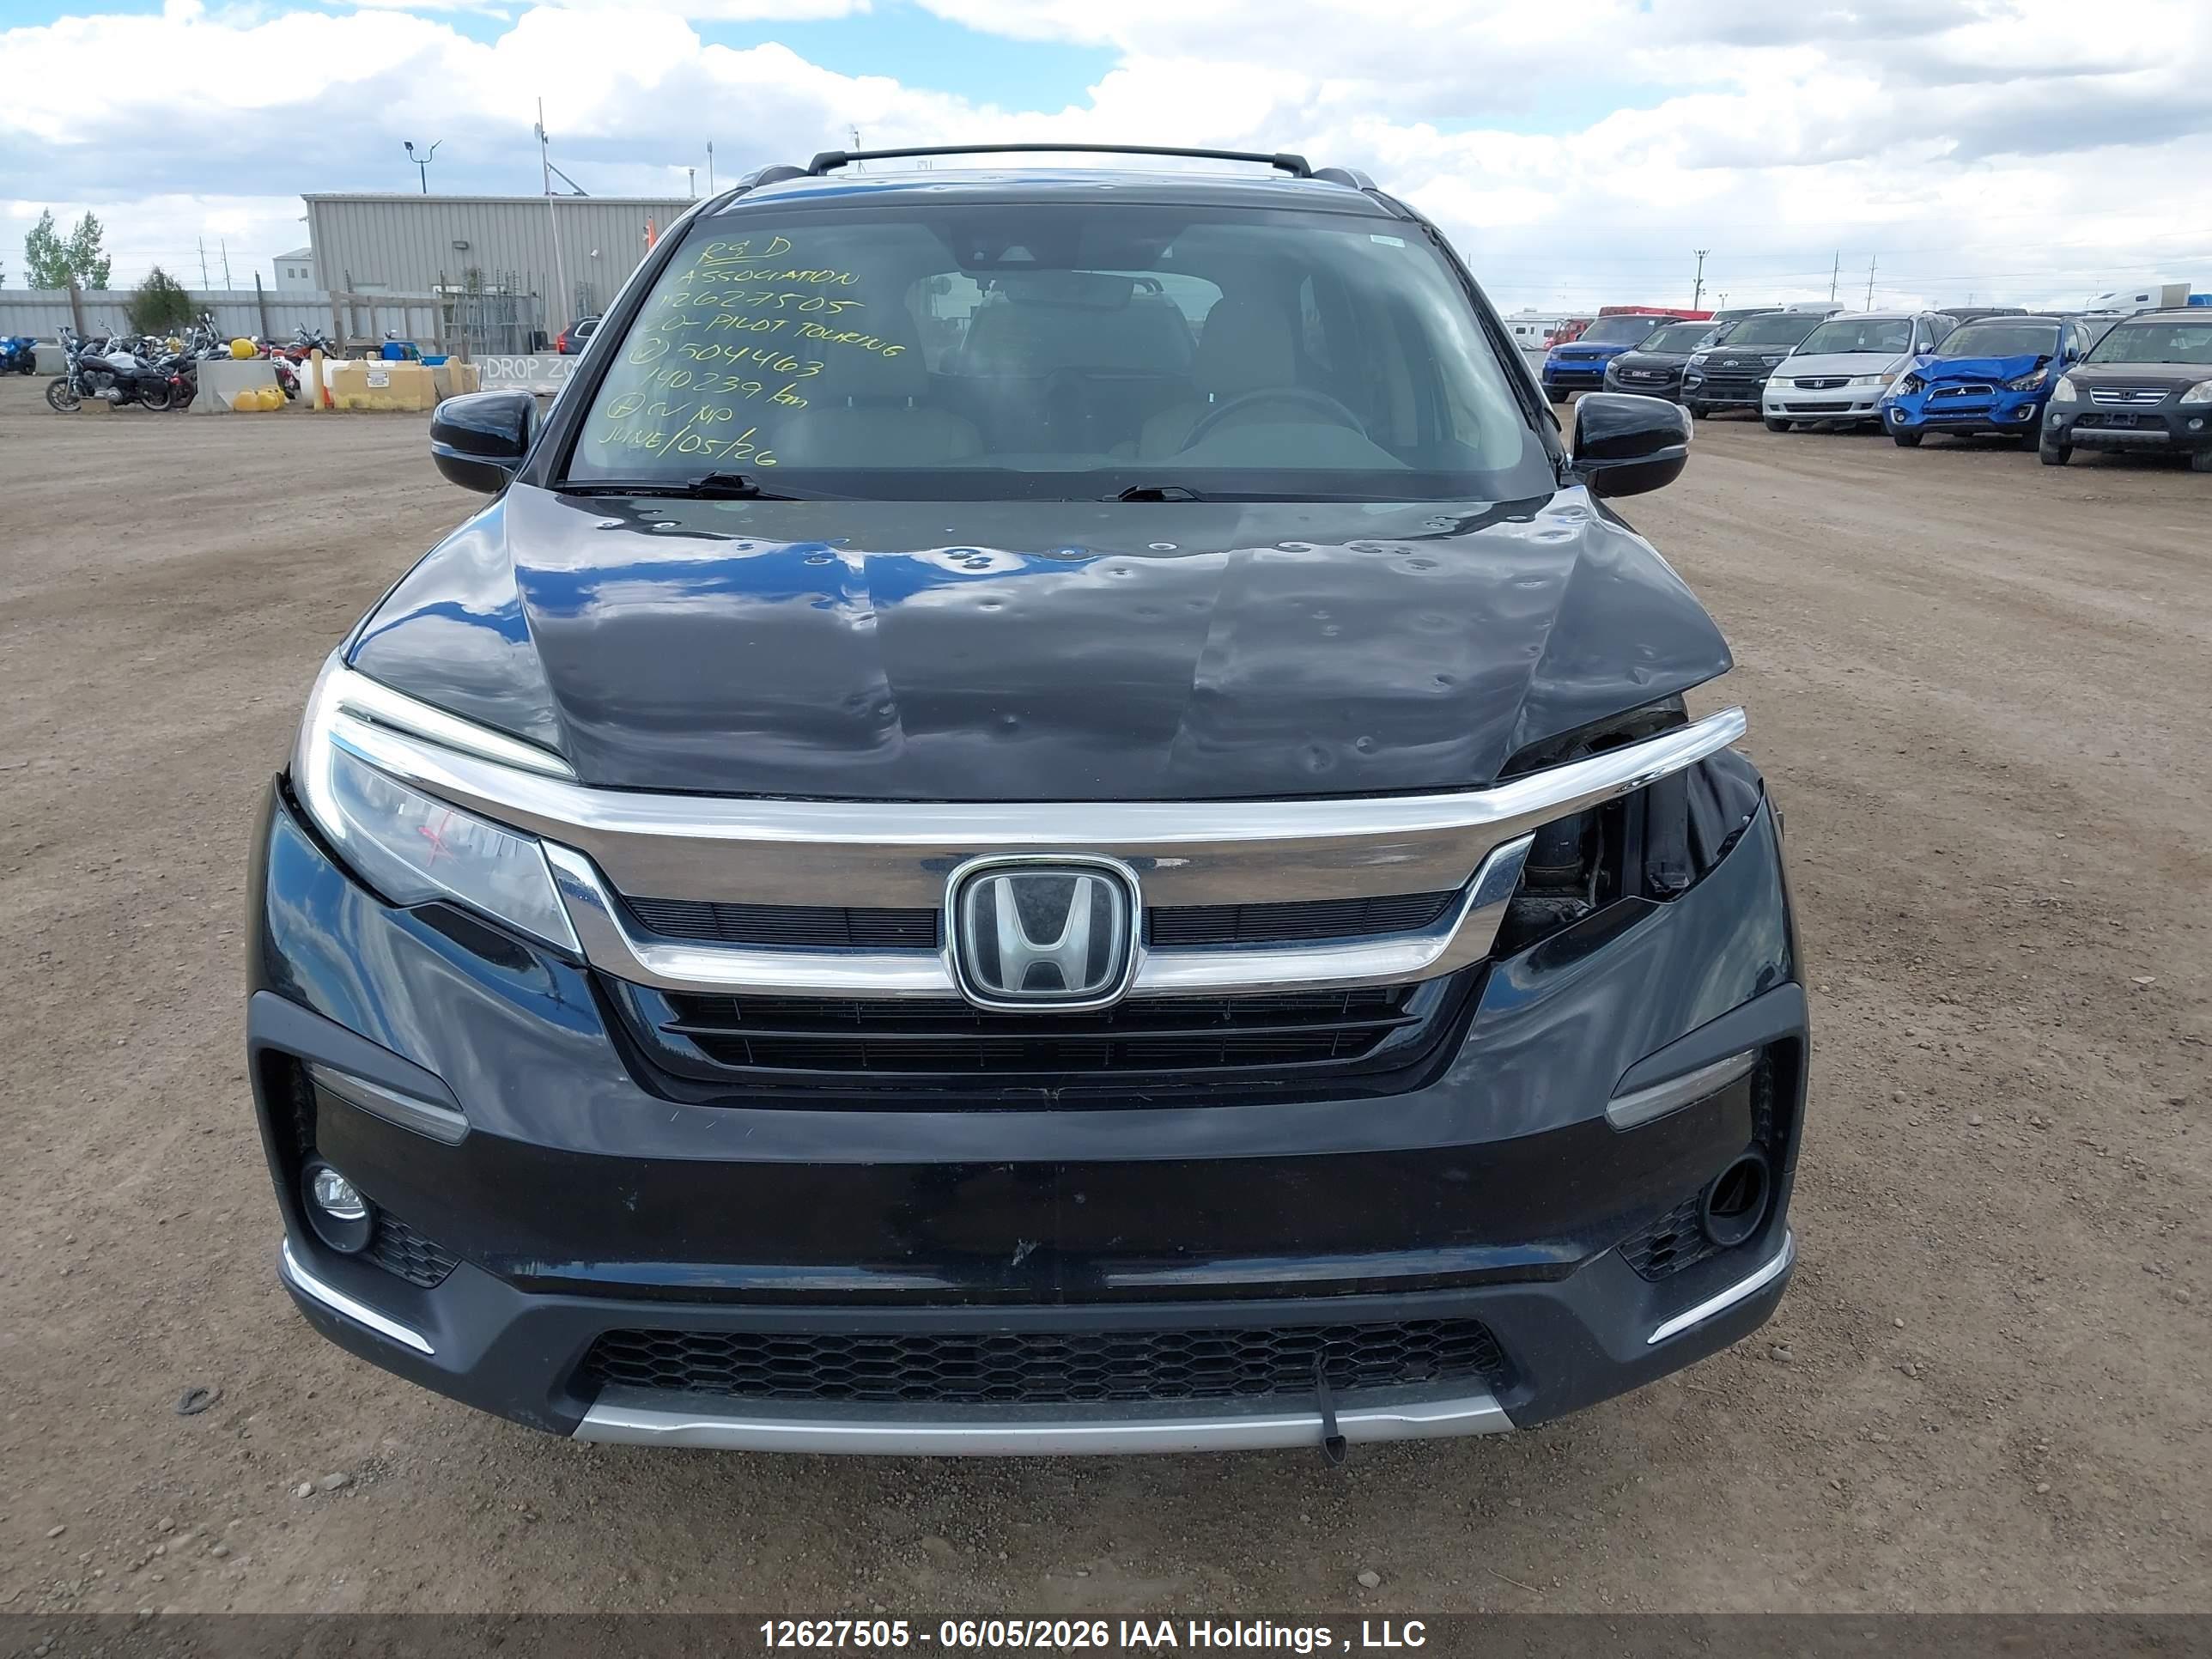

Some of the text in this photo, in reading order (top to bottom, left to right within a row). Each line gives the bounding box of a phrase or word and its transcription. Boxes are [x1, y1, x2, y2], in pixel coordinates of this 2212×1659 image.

[677, 270, 860, 285] ASSOCIATION
[657, 291, 866, 314] 12627505
[704, 313, 790, 332] PILOT
[794, 322, 906, 357] TOURING
[487, 357, 539, 379] DROP
[678, 343, 824, 377] 504463
[641, 368, 808, 410] 140239 km
